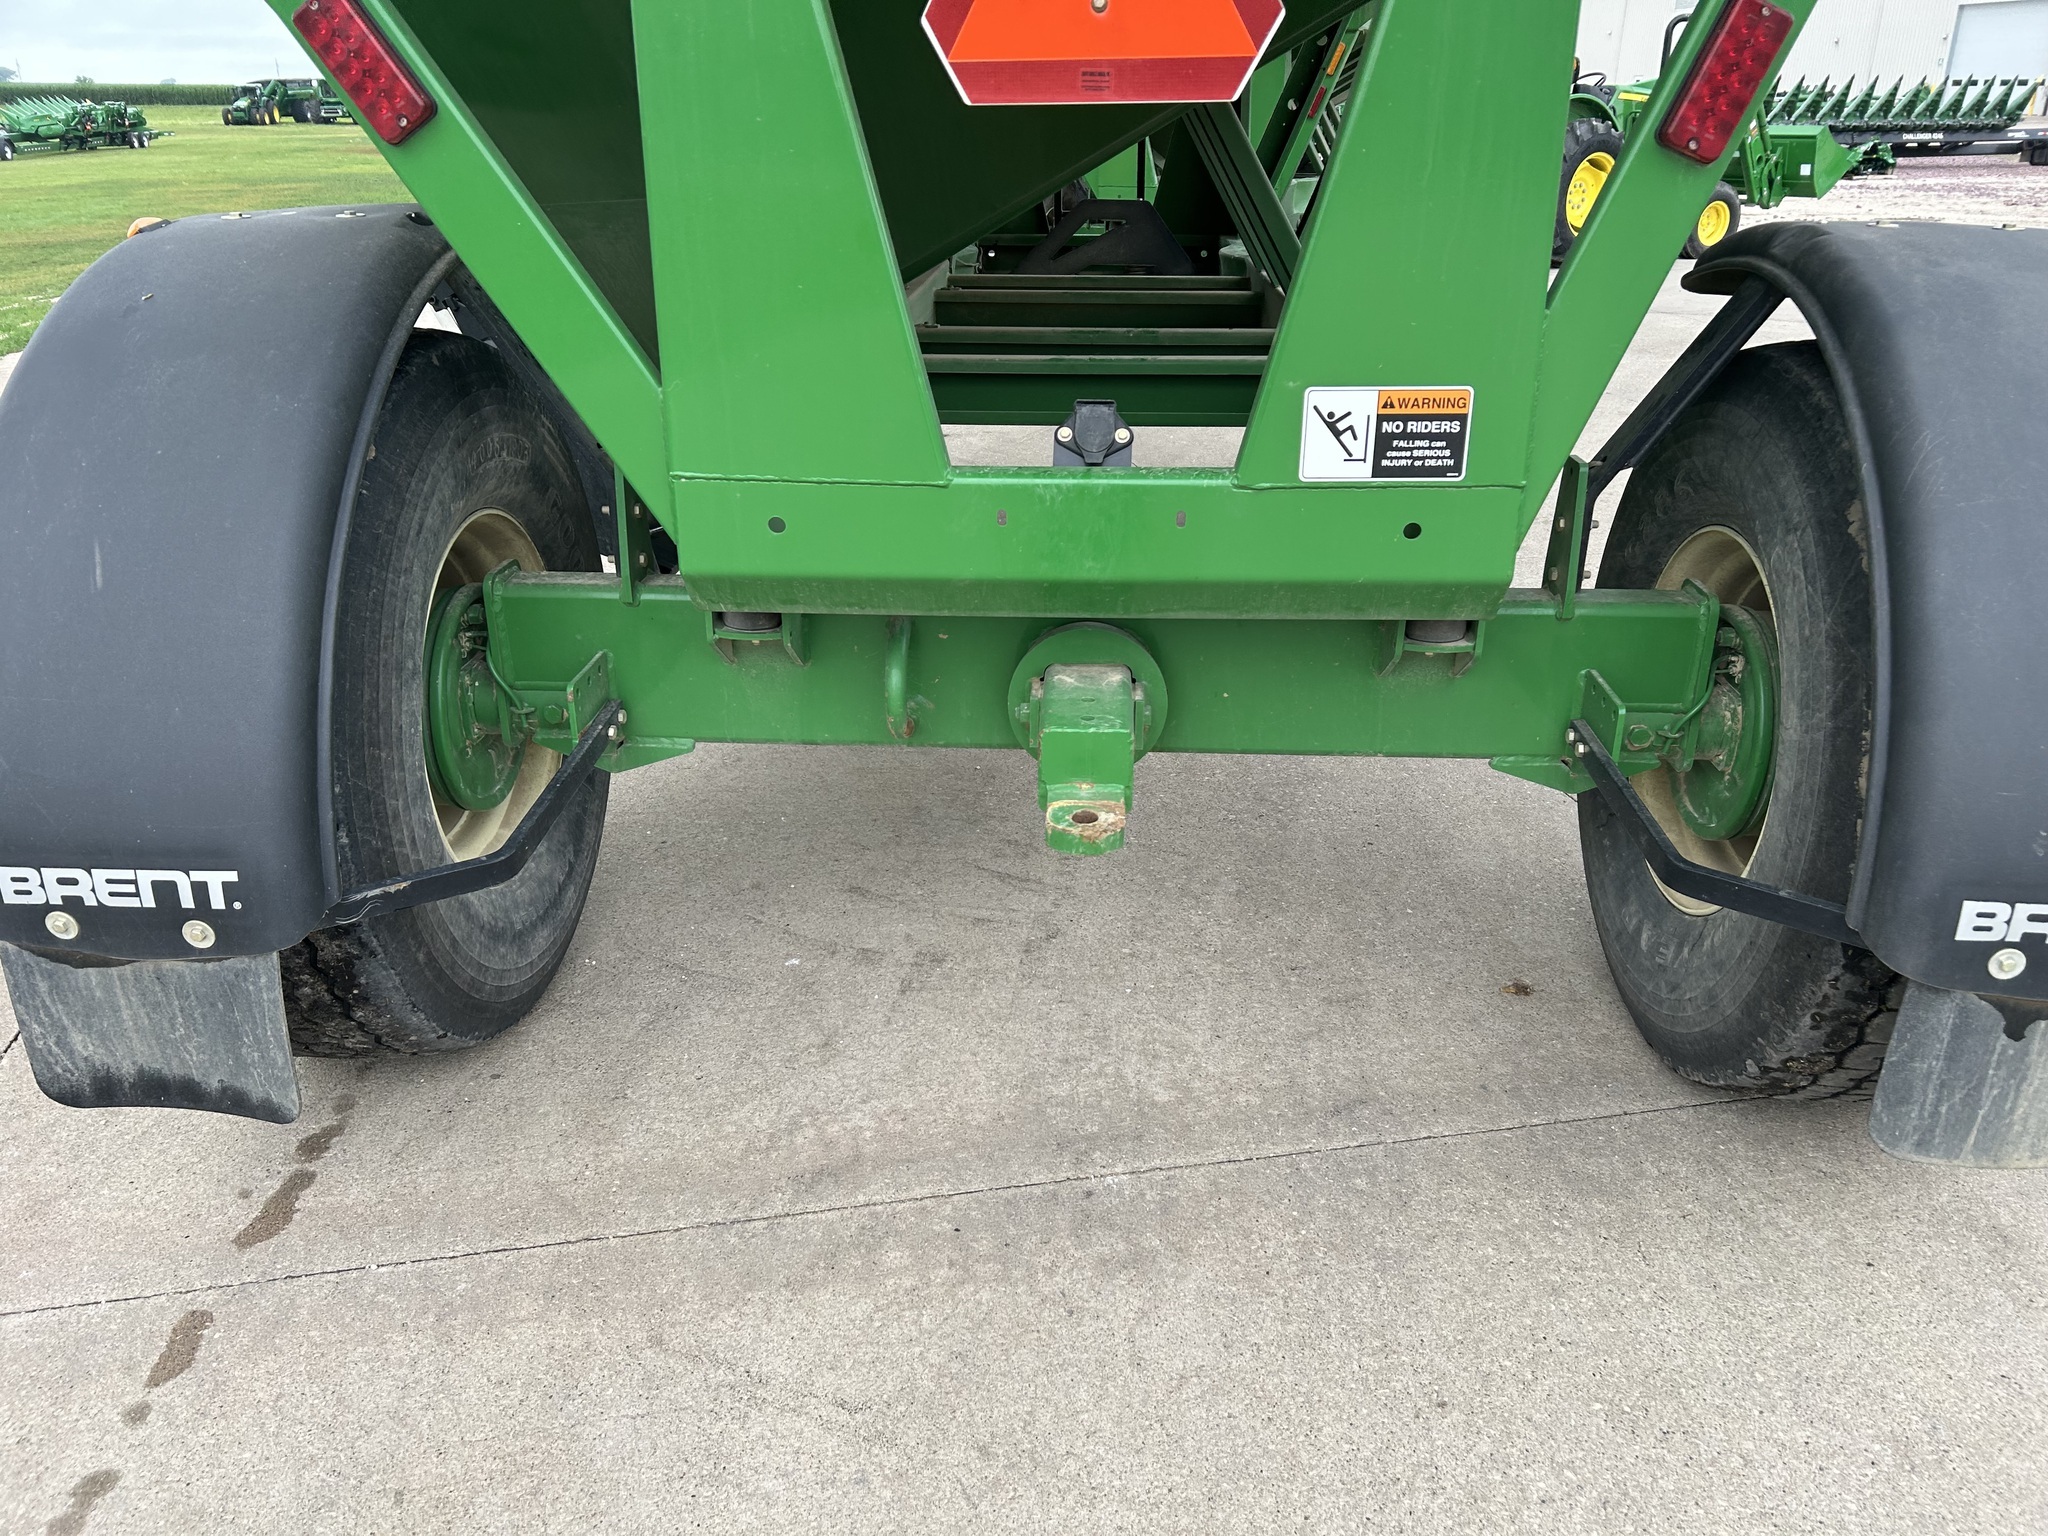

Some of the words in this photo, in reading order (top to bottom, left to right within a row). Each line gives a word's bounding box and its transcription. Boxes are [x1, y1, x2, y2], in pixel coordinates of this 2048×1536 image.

[1397, 397, 1467, 409] WARNING
[1381, 421, 1404, 433] NO
[1407, 421, 1461, 433] RIDERS
[1392, 439, 1430, 448] FALLING
[1431, 440, 1447, 448] can
[1386, 450, 1411, 458] cause
[1412, 449, 1451, 458] SERIOUS
[1381, 458, 1412, 467] INJURY
[1424, 458, 1455, 467] DEATH
[0, 866, 239, 910] BRENT
